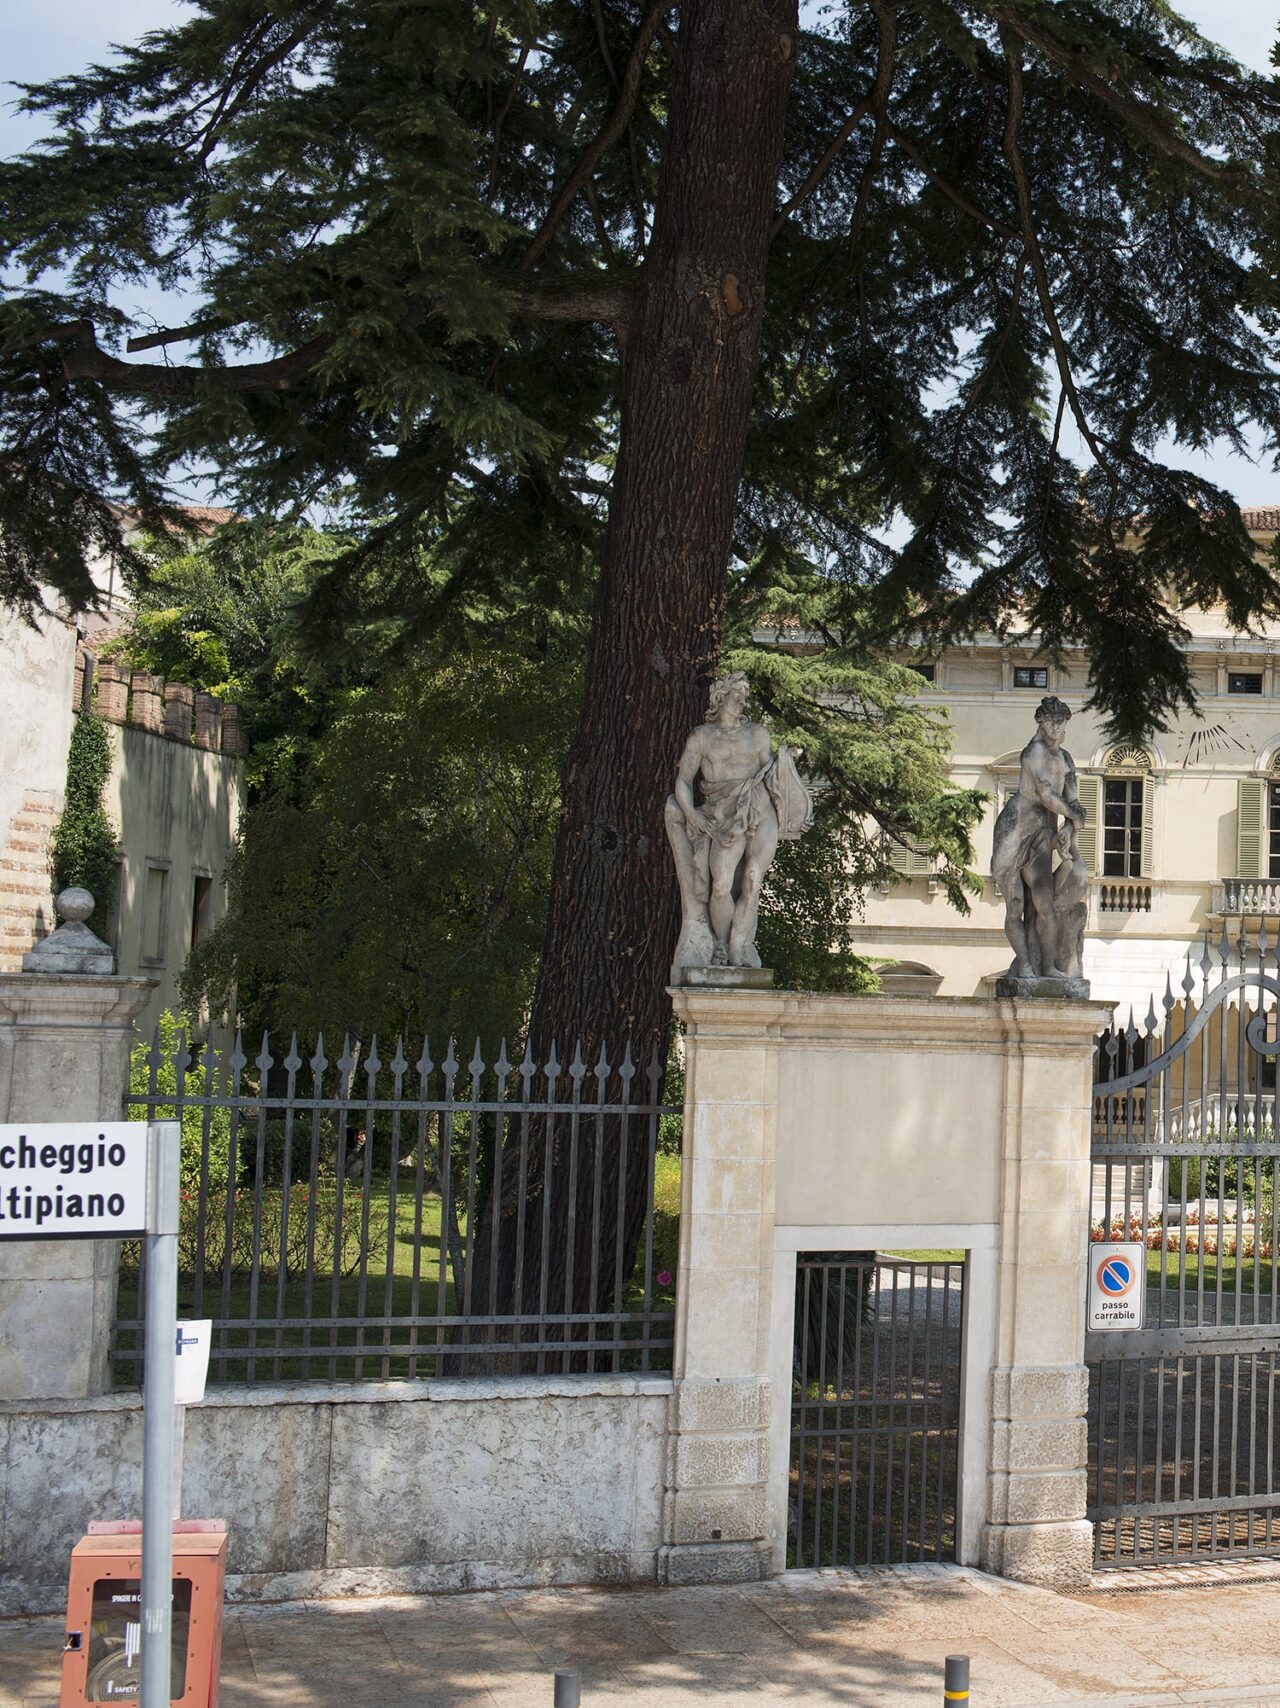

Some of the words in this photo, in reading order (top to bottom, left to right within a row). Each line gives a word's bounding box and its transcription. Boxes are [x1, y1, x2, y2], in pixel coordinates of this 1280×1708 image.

[0, 1133, 126, 1174] cheggio
[1102, 1301, 1129, 1310] passo
[1095, 1311, 1136, 1320] carrabile
